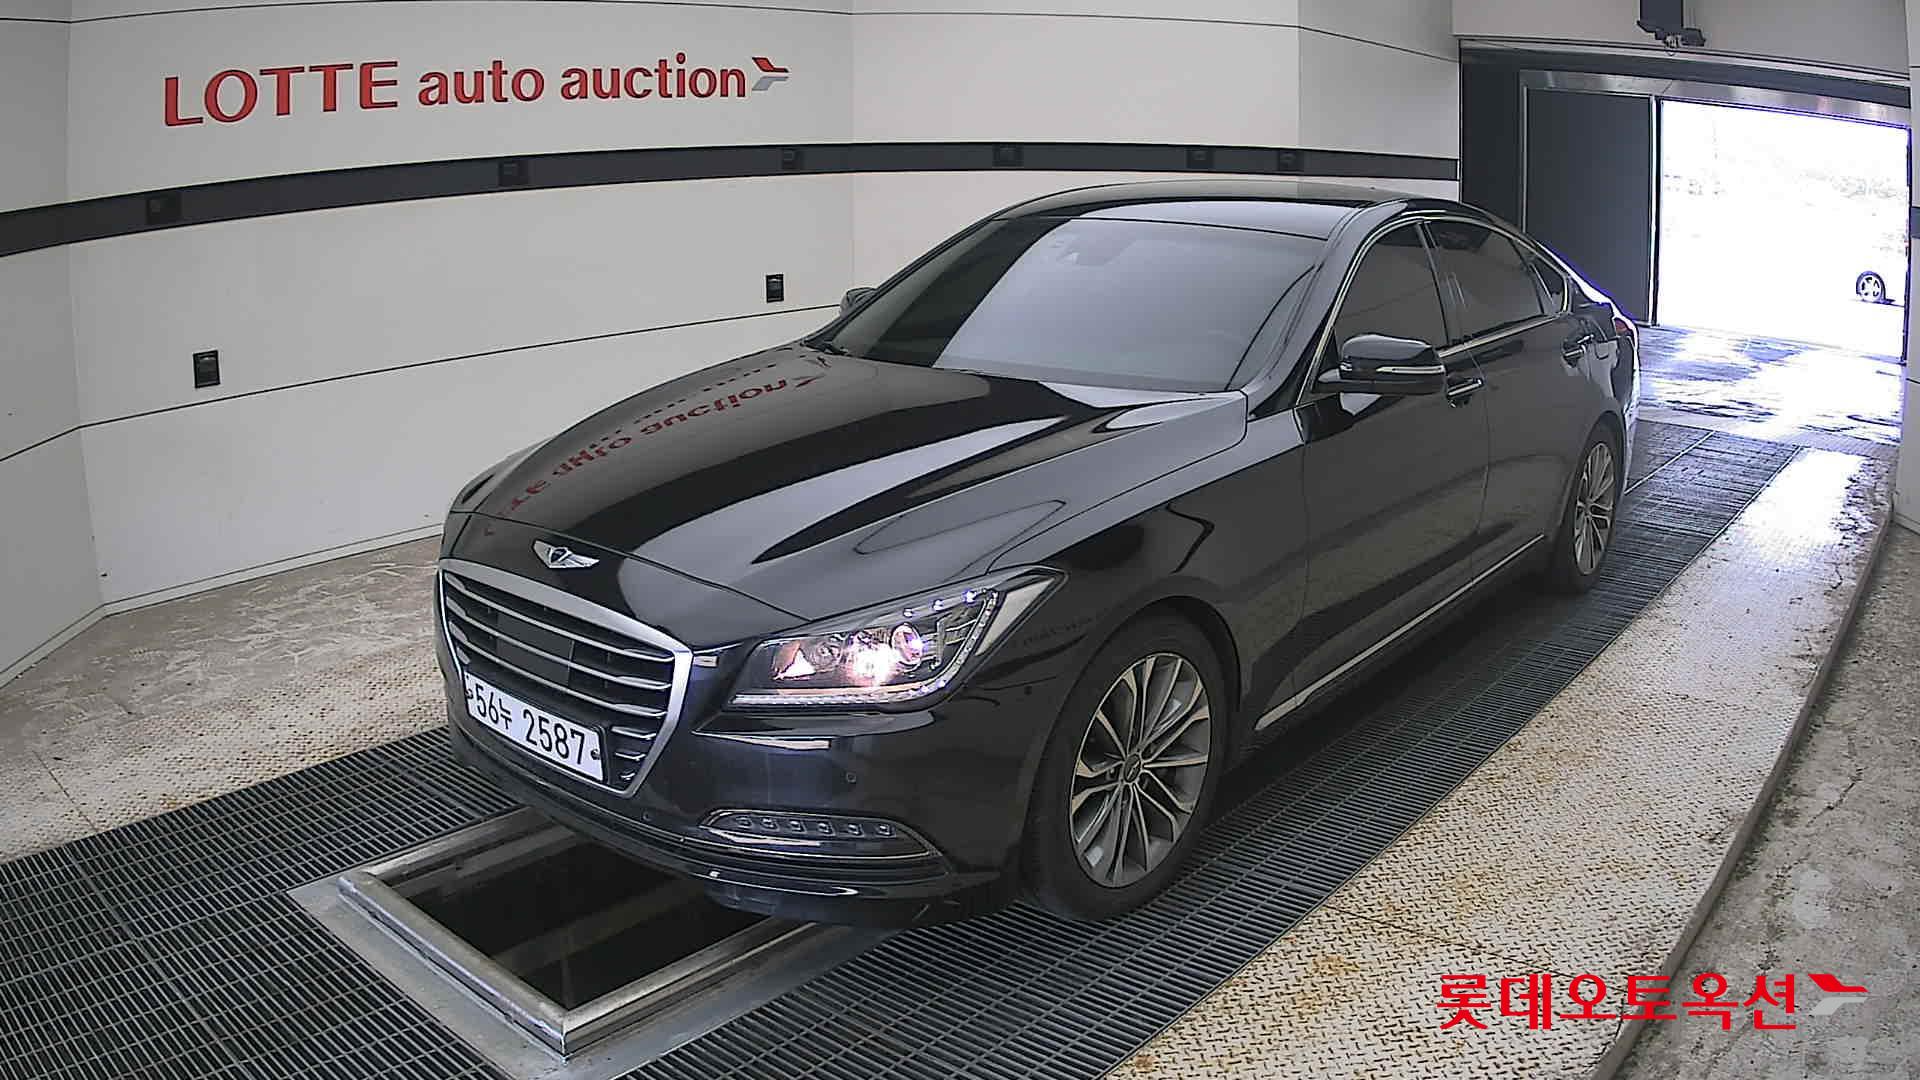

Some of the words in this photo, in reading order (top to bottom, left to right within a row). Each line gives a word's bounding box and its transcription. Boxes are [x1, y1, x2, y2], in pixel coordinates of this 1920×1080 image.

[164, 60, 399, 127] LOTTE
[418, 59, 546, 106] auto
[560, 52, 747, 101] auction
[475, 683, 513, 730] 56누
[522, 708, 586, 766] 2587
